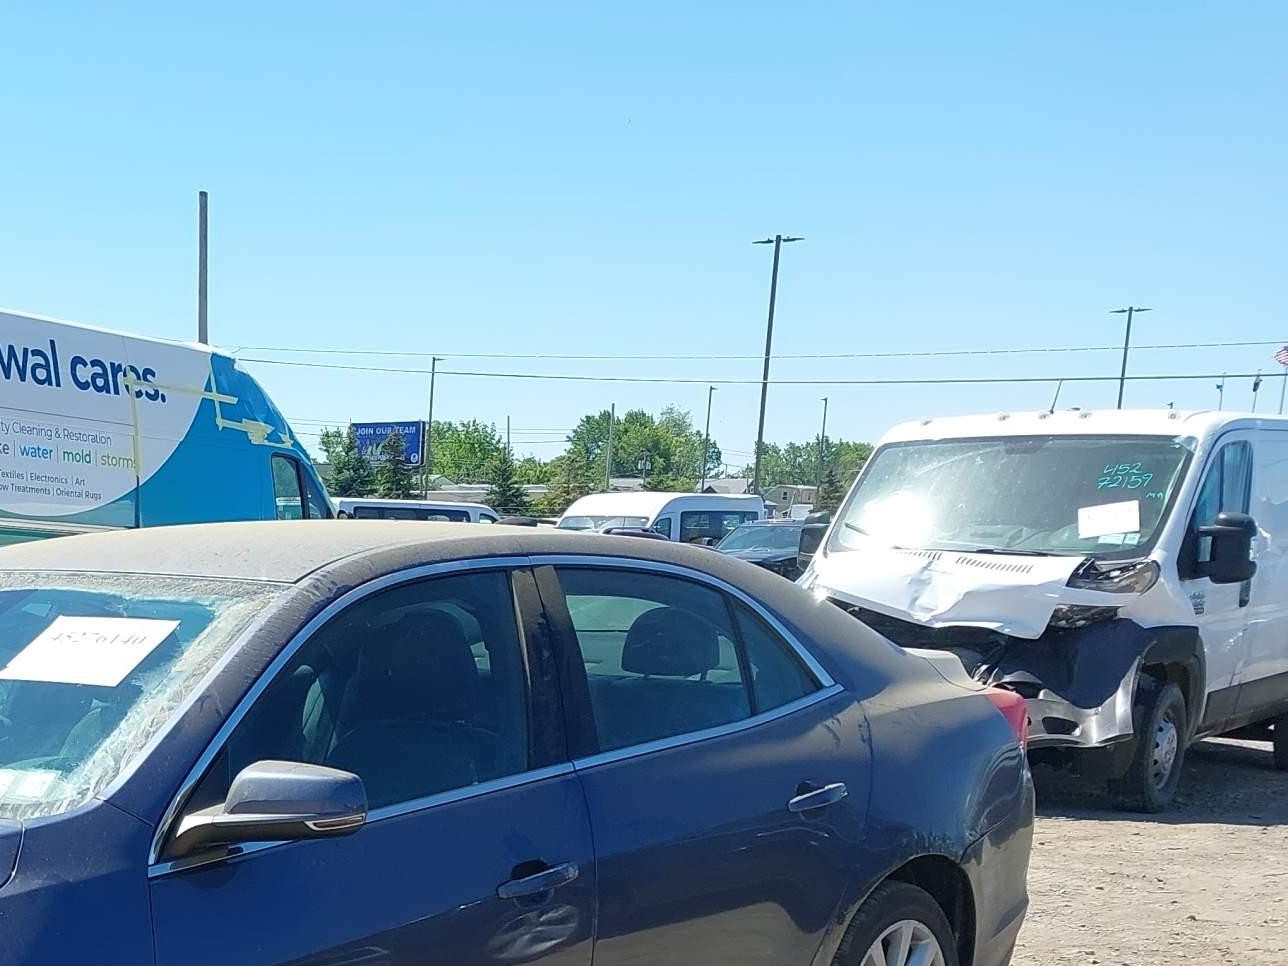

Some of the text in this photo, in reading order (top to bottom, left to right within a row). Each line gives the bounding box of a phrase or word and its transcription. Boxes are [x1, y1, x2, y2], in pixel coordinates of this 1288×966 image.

[70, 355, 167, 403] cares.
[12, 420, 53, 440] Cleaning
[54, 428, 62, 439] &
[63, 428, 112, 446] Restoration
[356, 425, 417, 435] JOIN OUR TEAM
[19, 445, 53, 460] water
[63, 448, 92, 464] mold
[29, 473, 68, 485] Electronics
[75, 477, 86, 486] Art
[11, 483, 51, 496] Treatments
[56, 488, 84, 499] Oriental
[84, 490, 102, 501] Rugs
